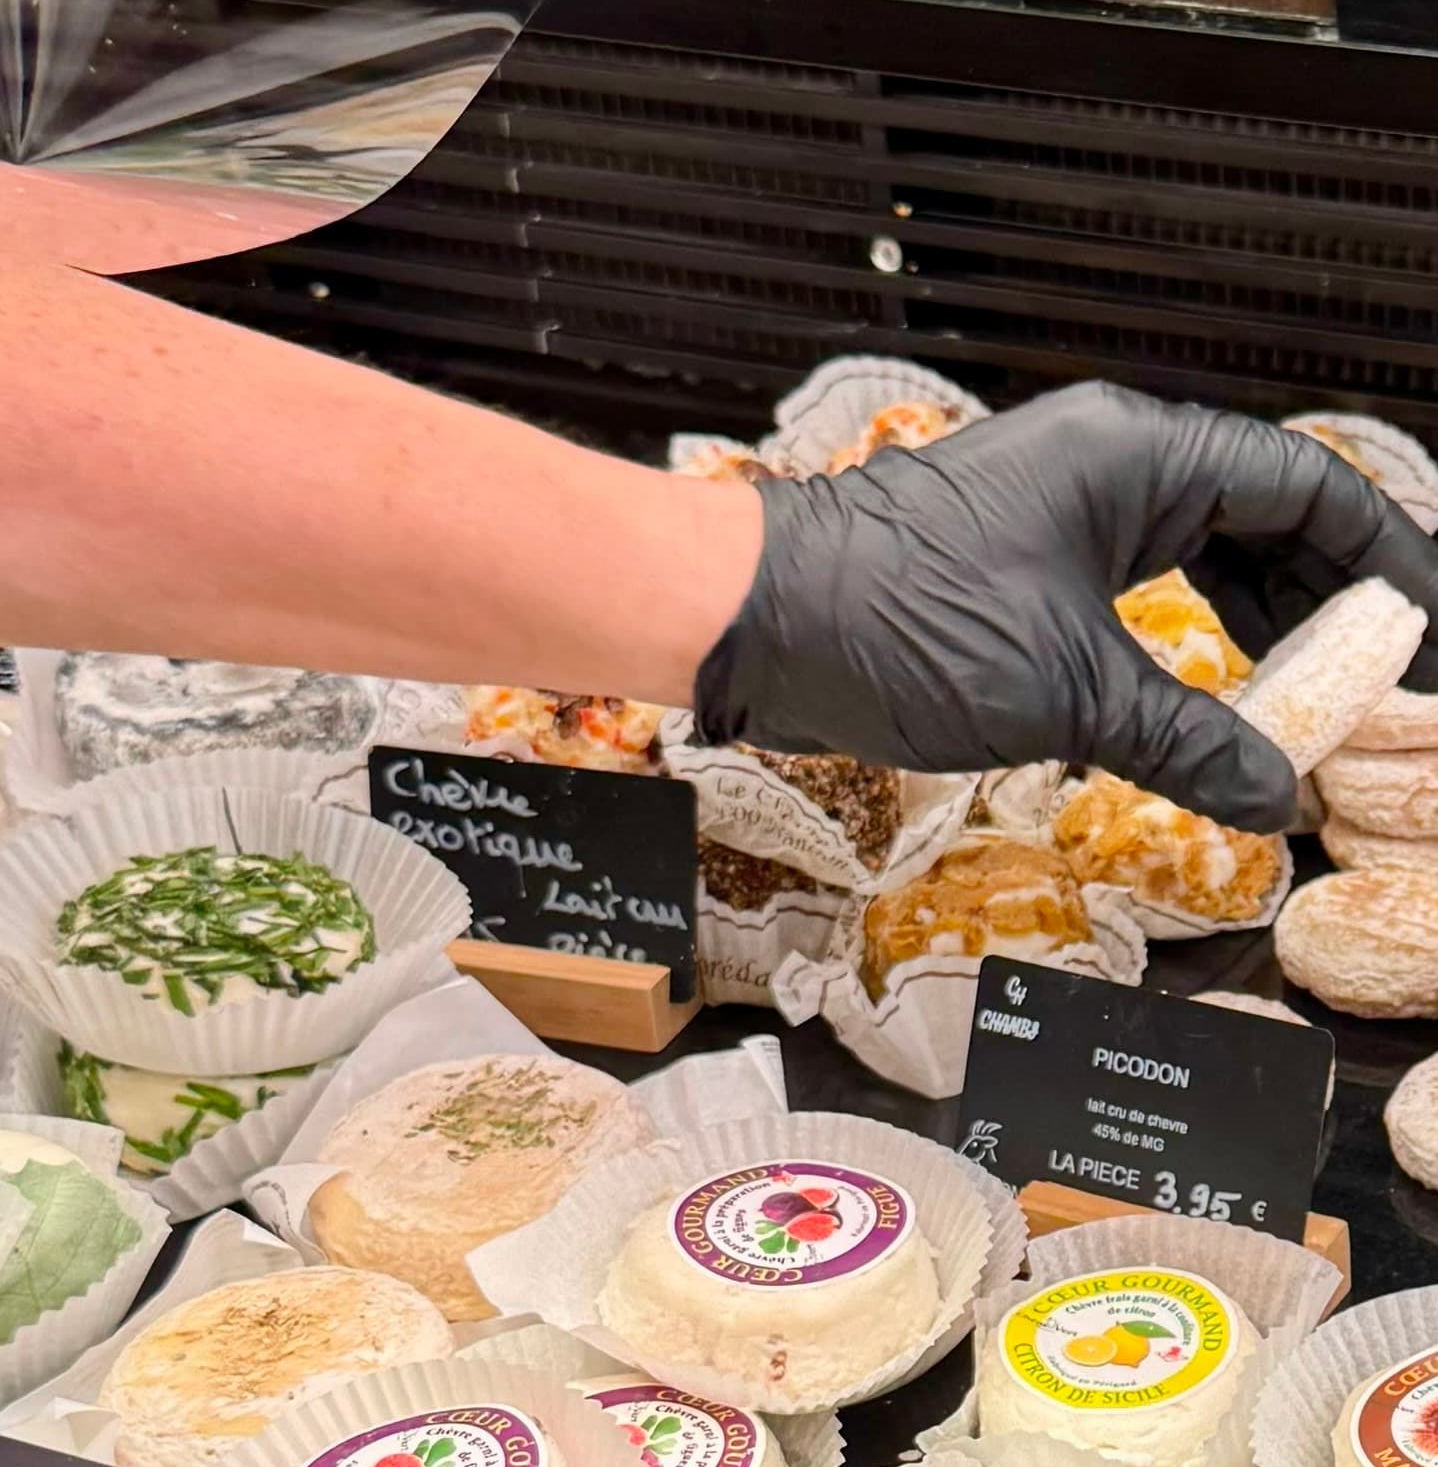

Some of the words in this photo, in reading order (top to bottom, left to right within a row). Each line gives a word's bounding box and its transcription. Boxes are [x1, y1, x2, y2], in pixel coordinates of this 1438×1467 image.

[1092, 1047, 1190, 1089] PICODON
[1087, 1097, 1106, 1114] lait
[1108, 1105, 1126, 1120] cru
[1129, 1109, 1144, 1123] de
[1094, 1123, 1120, 1142] 45%
[1123, 1131, 1139, 1146] de
[1141, 1135, 1165, 1152] MG
[867, 1185, 900, 1229] FIGUE
[1049, 1149, 1075, 1174] LA
[1080, 1157, 1141, 1190] PIECE
[1153, 1171, 1242, 1221] 3.95
[1252, 1200, 1267, 1221] €
[683, 1169, 768, 1253] GOURMAND
[1033, 1280, 1109, 1315] CŒUR
[1121, 1274, 1224, 1351] GOURMAND
[1014, 1342, 1066, 1394] CITRON
[1068, 1389, 1095, 1404] DE
[1102, 1383, 1170, 1404] SICILE
[426, 1412, 512, 1434] CŒUR
